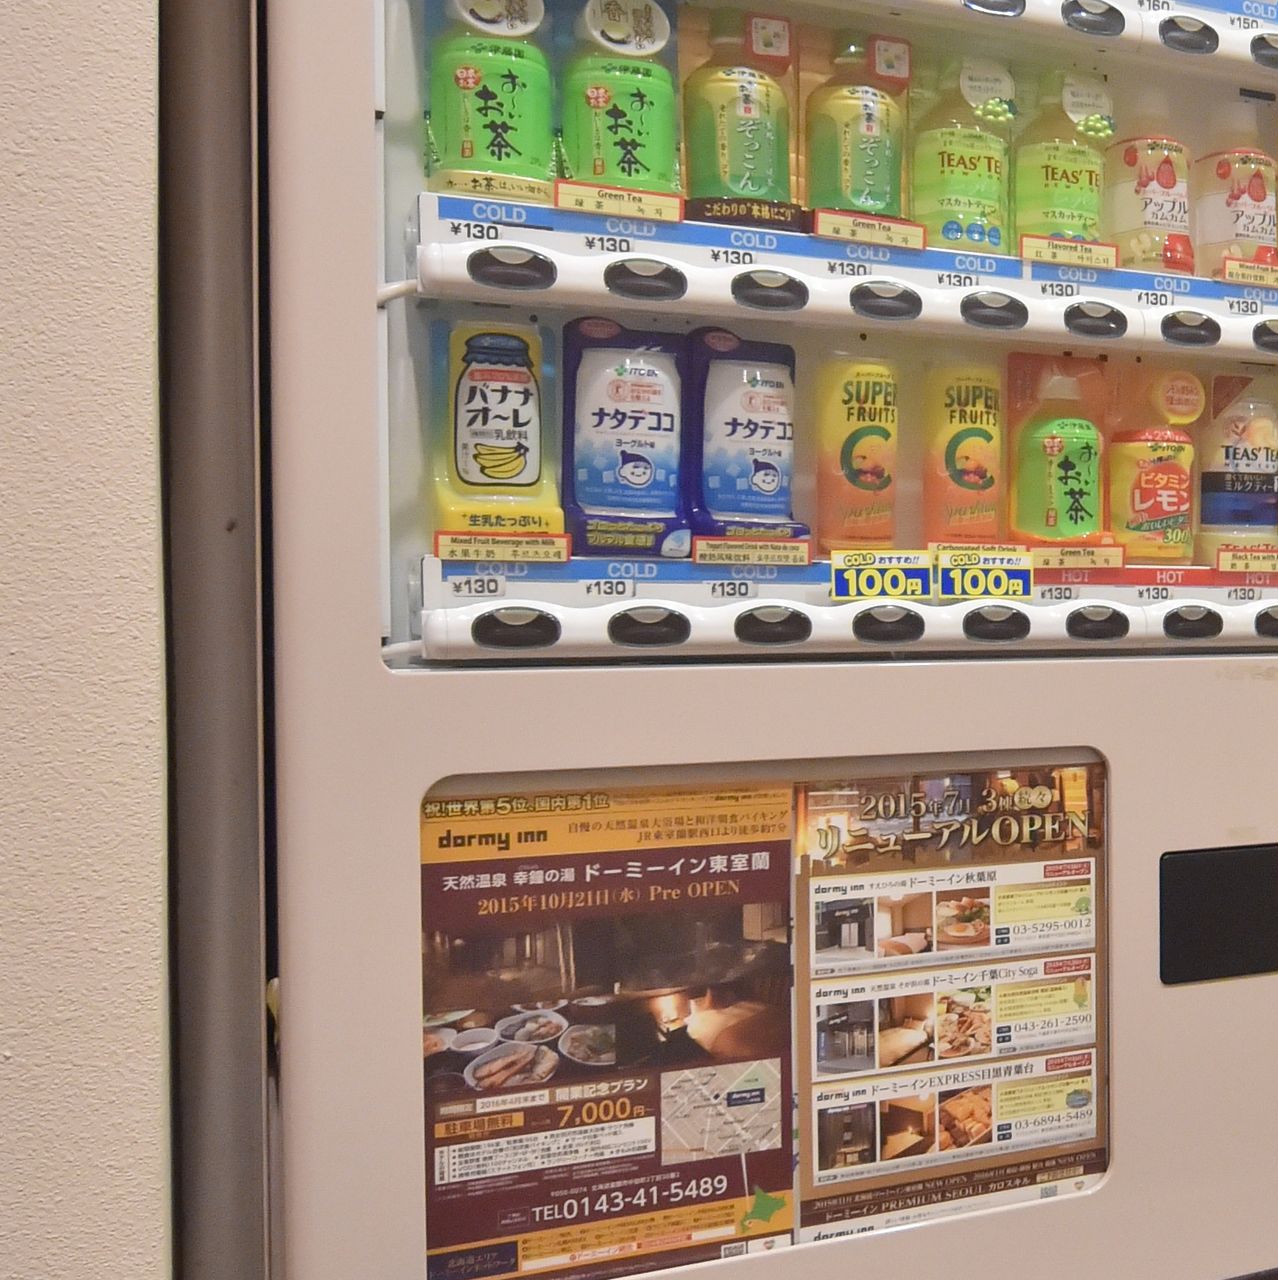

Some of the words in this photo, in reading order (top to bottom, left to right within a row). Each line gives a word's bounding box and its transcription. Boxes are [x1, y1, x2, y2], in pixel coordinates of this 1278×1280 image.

[1243, 1, 1277, 19] COLD
[598, 190, 625, 202] Green
[627, 193, 642, 204] Tea
[1140, 197, 1188, 215] アップル
[473, 202, 527, 222] COLD
[450, 222, 499, 240] ¥130
[852, 218, 876, 230] Green
[585, 236, 631, 253] ¥130
[730, 231, 778, 250] COLD
[711, 249, 753, 265] ¥130
[955, 255, 997, 273] COLD
[1041, 282, 1074, 297] ¥130
[1154, 276, 1191, 293] COLD
[464, 384, 534, 406] バナナ
[591, 406, 674, 433] ナタデココ
[846, 405, 896, 424] FRUITS
[949, 409, 997, 427] FRUITS
[494, 428, 529, 442] 乳飲料
[724, 417, 793, 441] ナタデココ
[1220, 444, 1262, 462] TEAS'
[468, 514, 543, 529] 生乳たっぷり
[843, 553, 876, 566] COLD
[950, 553, 980, 566] COLD
[1060, 548, 1080, 557] Green
[607, 562, 657, 578] COLD
[1156, 570, 1184, 583] HOT
[453, 578, 499, 596] ¥130
[843, 568, 922, 596] 100円
[949, 568, 1023, 596] 100円
[1138, 587, 1169, 600] ¥130
[438, 830, 510, 852] dormy
[517, 829, 548, 844] inn
[818, 810, 1091, 860] リニューアルOPEN
[442, 872, 507, 892] 天然温泉
[584, 851, 771, 884] ドーミーイン東室蘭
[649, 884, 681, 901] Pre
[687, 879, 741, 898] OPEN
[814, 883, 848, 896] dormy
[849, 882, 865, 892] inn
[909, 870, 998, 889] ドーミーイン秋葉原
[1012, 918, 1092, 936] 03-5295-0012
[815, 987, 849, 999] dormy
[851, 986, 866, 994] inn
[1013, 1013, 1092, 1033] 043-261-2590
[816, 1090, 850, 1102] dormy
[852, 1089, 867, 1097] inn
[1014, 1108, 1094, 1130] 03-6894-5489
[881, 1191, 942, 1213] PREMIUM
[944, 1184, 986, 1201] SEOUL
